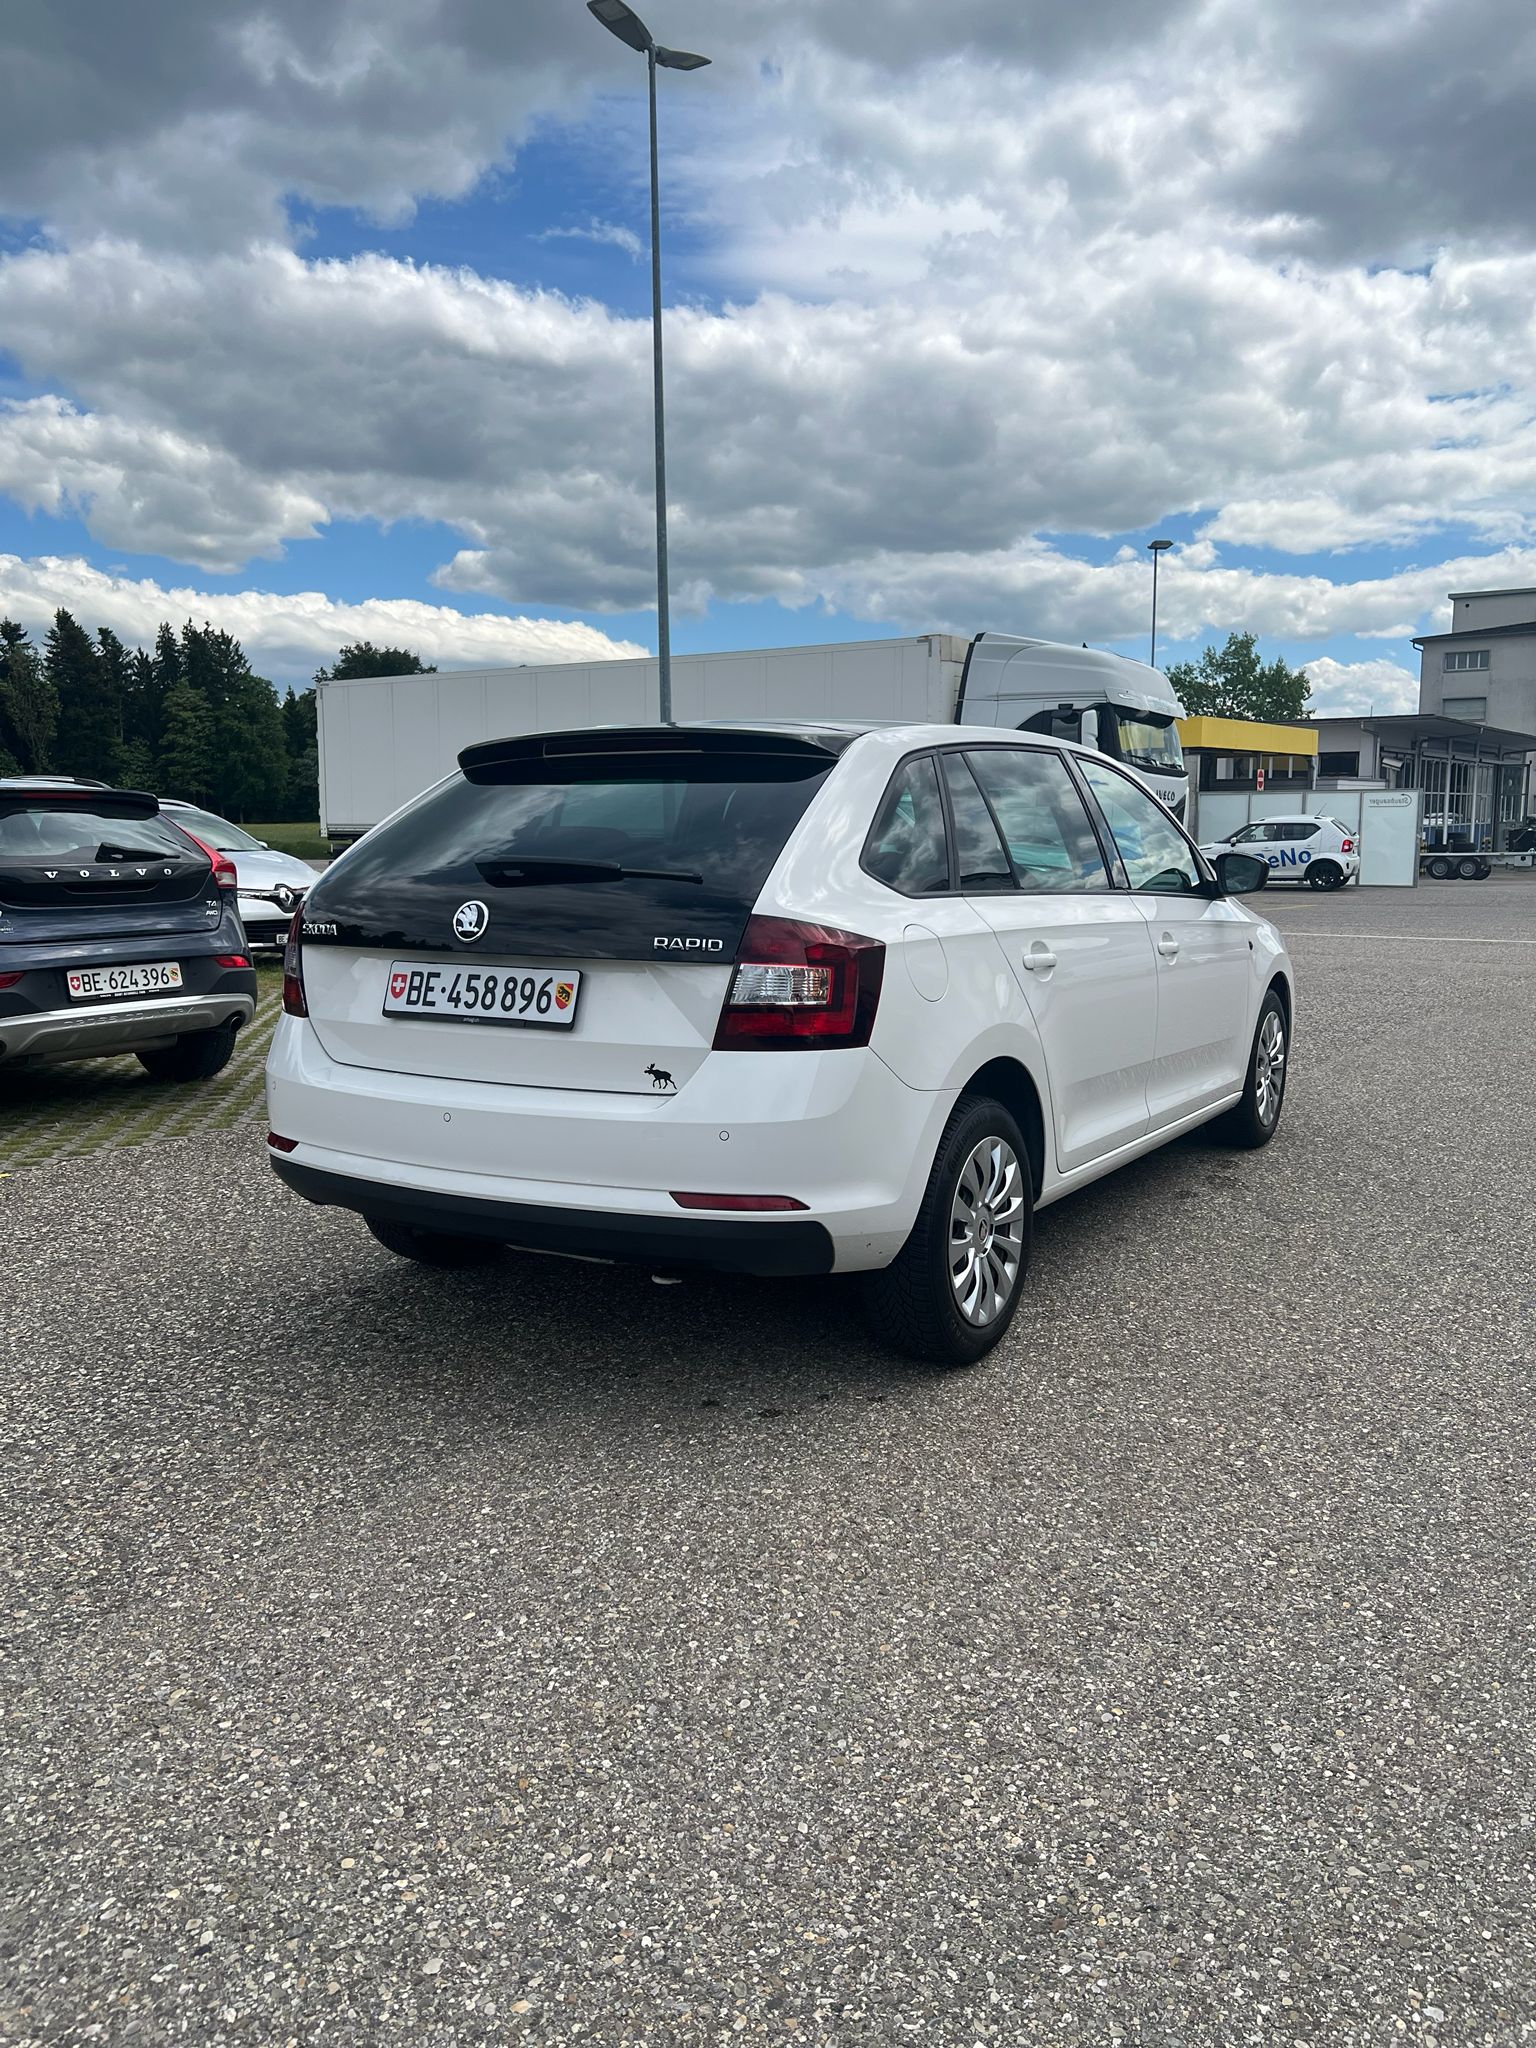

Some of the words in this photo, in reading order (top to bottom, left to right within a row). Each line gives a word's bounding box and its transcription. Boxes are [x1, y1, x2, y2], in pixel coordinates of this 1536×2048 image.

[1156, 789, 1176, 801] IVECO
[44, 868, 172, 879] VOLVO
[653, 936, 723, 952] RAPID
